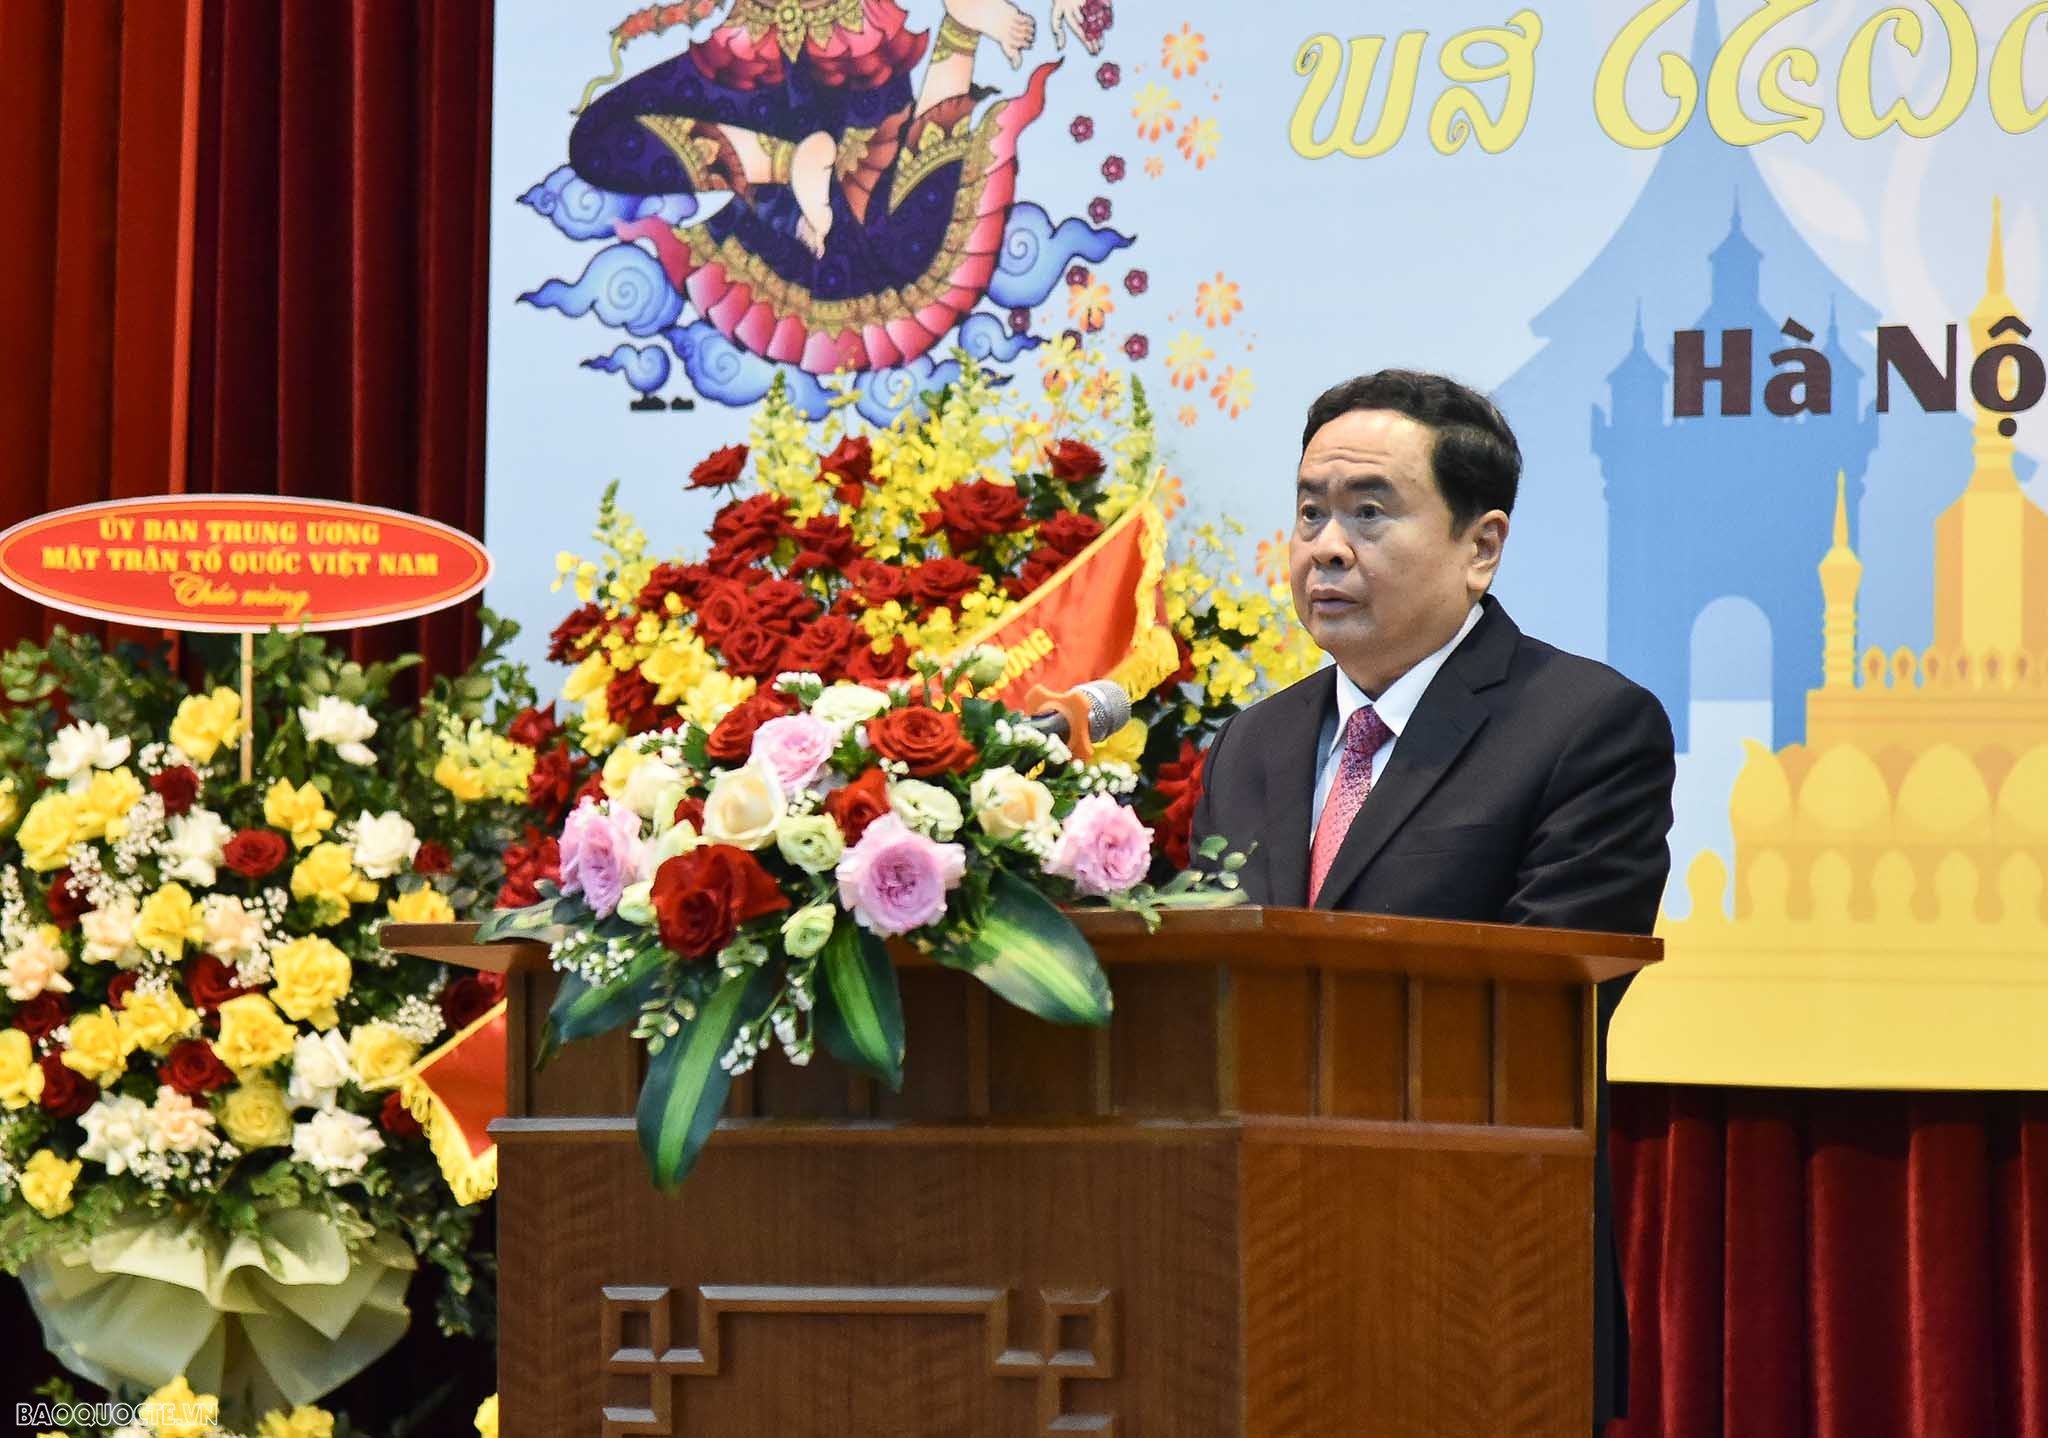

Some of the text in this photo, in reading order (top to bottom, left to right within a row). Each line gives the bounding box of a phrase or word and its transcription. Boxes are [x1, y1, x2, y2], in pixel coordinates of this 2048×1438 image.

[1673, 316, 1833, 417] Hà
[144, 518, 199, 543] BAN
[206, 519, 299, 545] TRUNG
[306, 520, 380, 546] ƯƠNG
[229, 545, 301, 576] QUỐC
[308, 548, 371, 578] VIỆT
[378, 552, 439, 577] NAM
